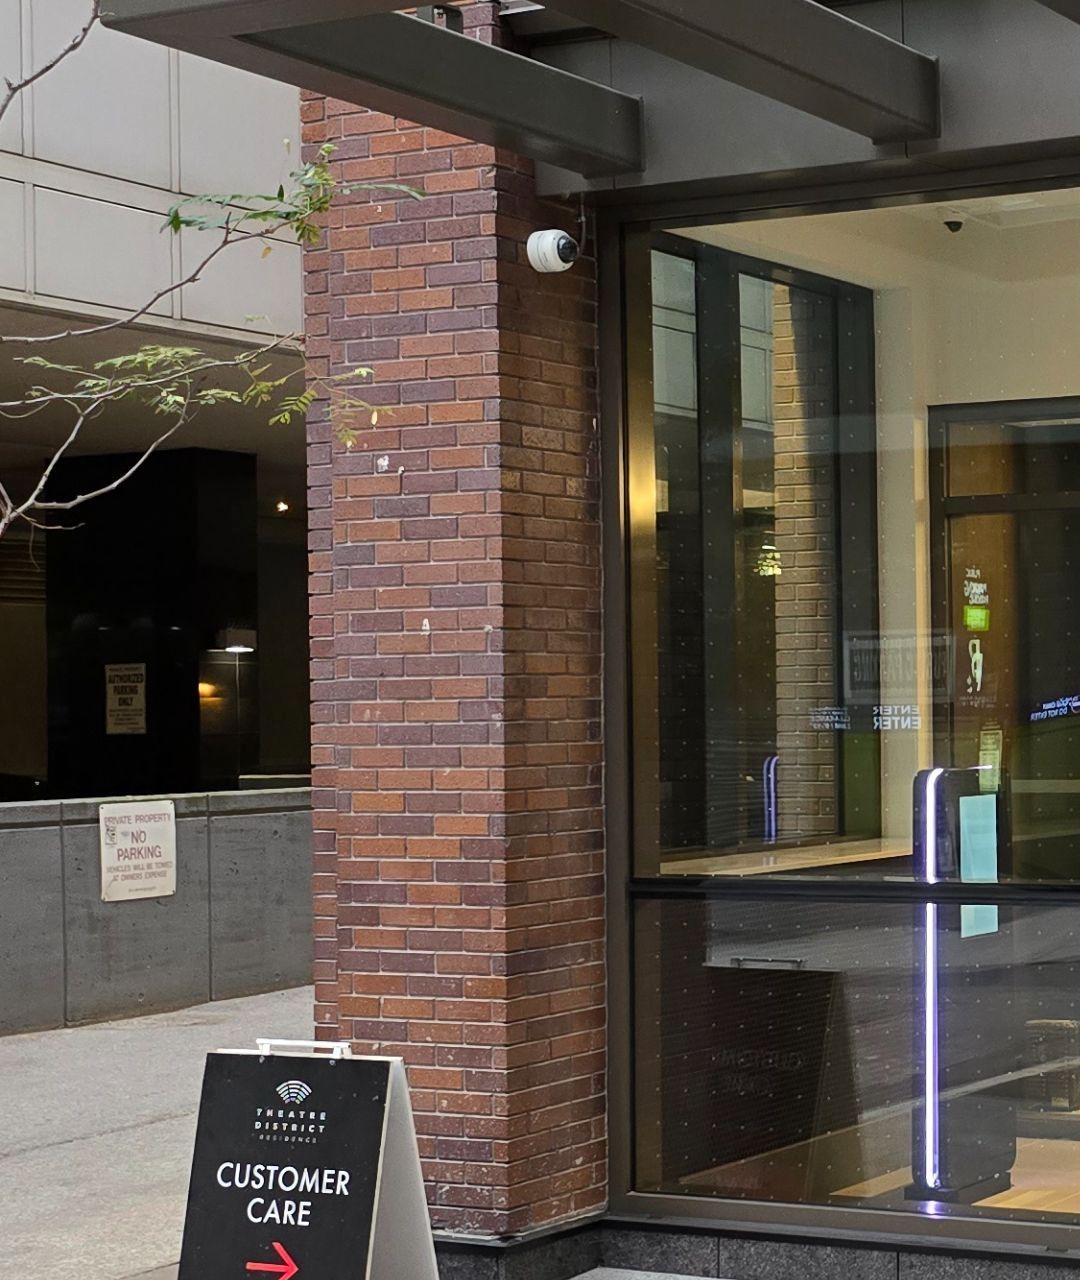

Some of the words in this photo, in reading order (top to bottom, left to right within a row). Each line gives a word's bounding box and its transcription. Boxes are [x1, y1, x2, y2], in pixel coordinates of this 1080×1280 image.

[103, 815, 133, 825] PRIVATE
[134, 812, 172, 824] PROPERTY
[130, 830, 147, 844] NO
[116, 845, 162, 861] PARKING
[256, 1108, 327, 1120] THEATRE
[254, 1121, 326, 1133] DISTRICT
[216, 1161, 350, 1196] CUSTOMER
[246, 1197, 312, 1227] CARE
